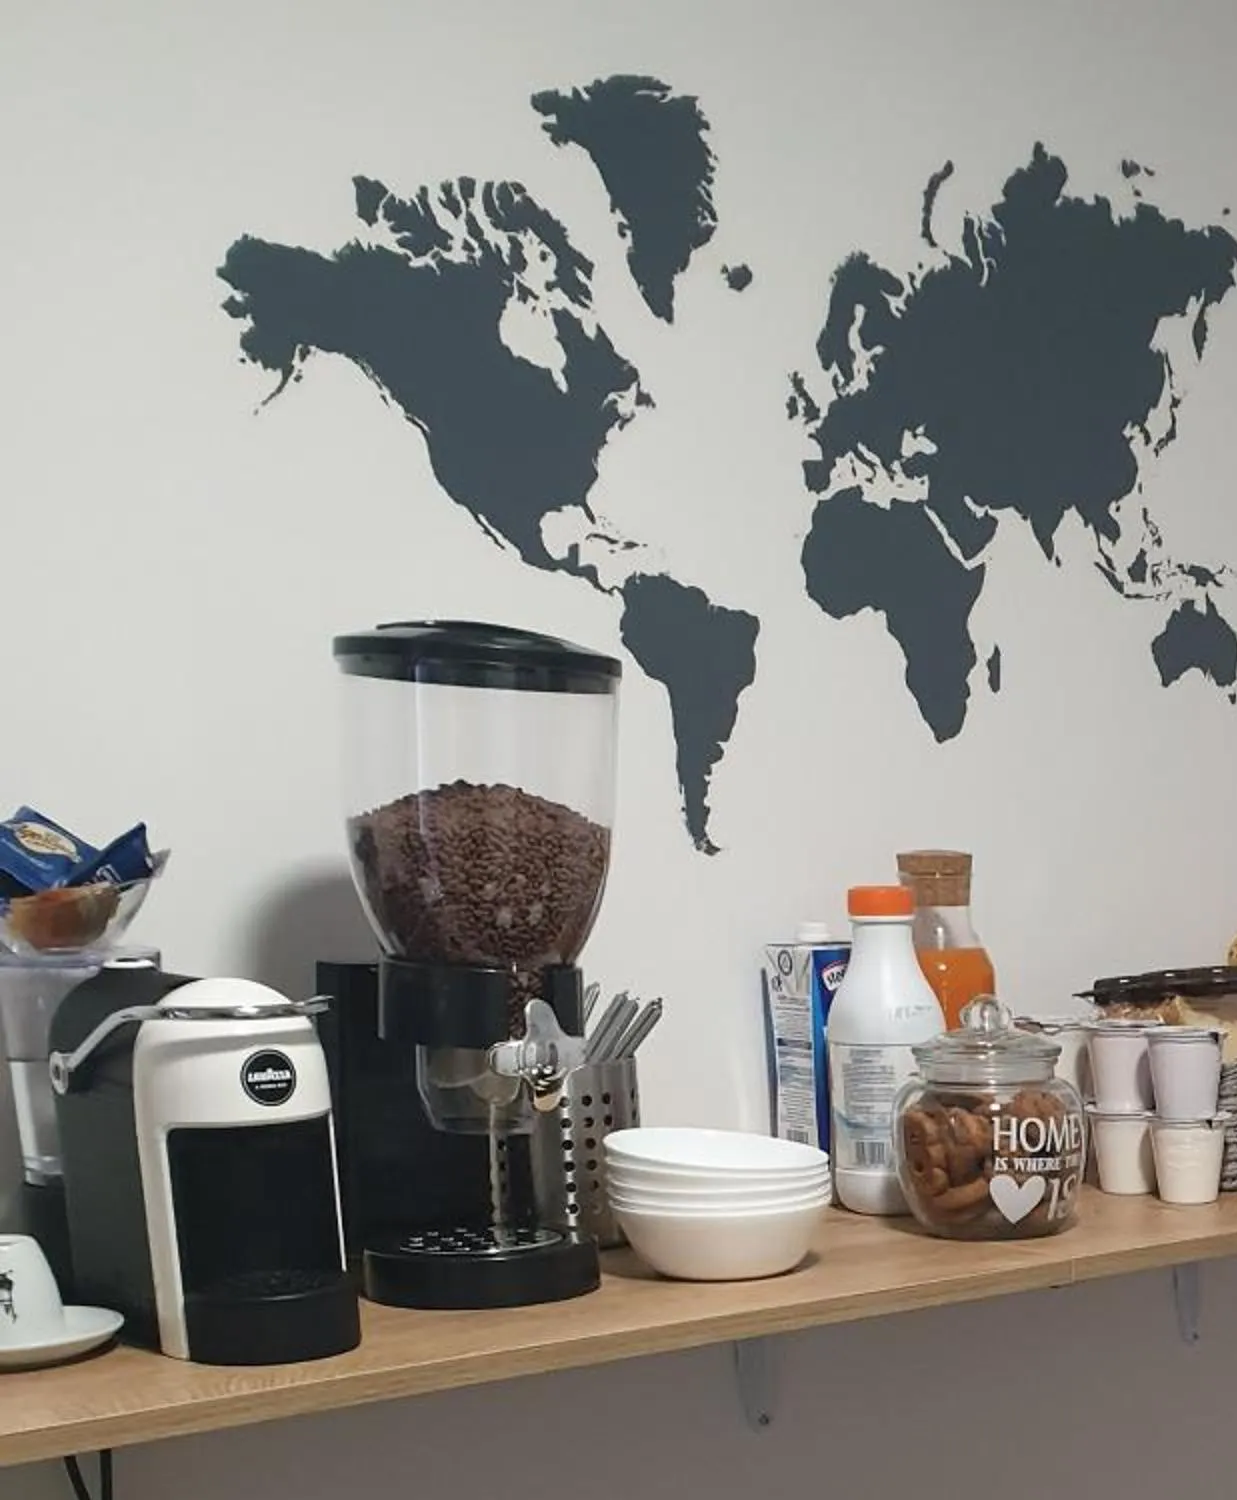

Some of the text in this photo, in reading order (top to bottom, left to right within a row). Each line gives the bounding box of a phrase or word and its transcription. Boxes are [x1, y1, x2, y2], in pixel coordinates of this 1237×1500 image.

[992, 1113, 1081, 1153] HOME
[994, 1157, 1009, 1171] IS
[1013, 1156, 1062, 1172] WHERE
